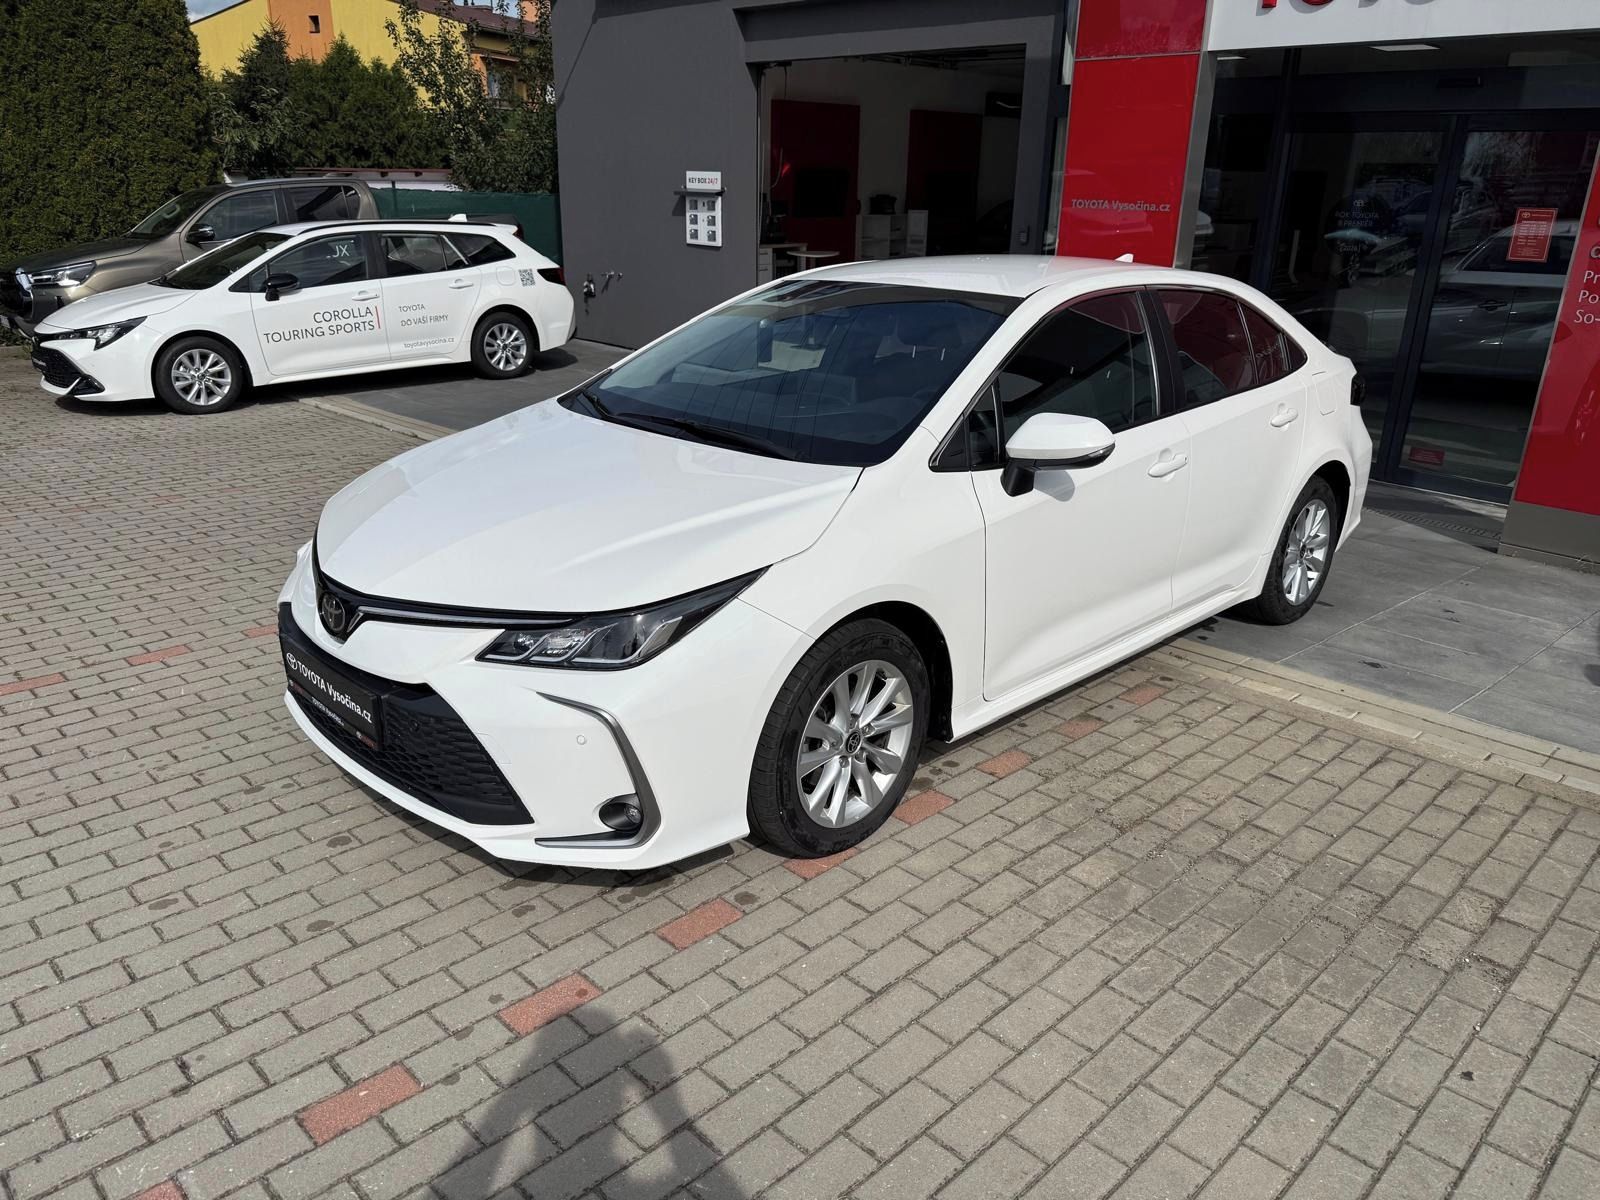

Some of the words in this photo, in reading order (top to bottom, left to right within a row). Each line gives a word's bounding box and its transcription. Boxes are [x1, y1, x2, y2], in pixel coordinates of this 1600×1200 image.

[707, 177, 718, 185] 24/7
[1071, 199, 1109, 209] TOYOTA
[1111, 200, 1171, 212] Vysočina.cz
[398, 303, 426, 313] TOYOTA
[313, 306, 374, 325] COROLLA
[400, 318, 413, 327] DO
[429, 314, 449, 323] FIRMY
[263, 326, 326, 344] TOURING
[328, 320, 375, 336] SPORTS
[403, 336, 455, 349] toyotavysocina.cz
[297, 660, 327, 692] TOYOTA
[326, 681, 373, 724] Vysočina.cz
